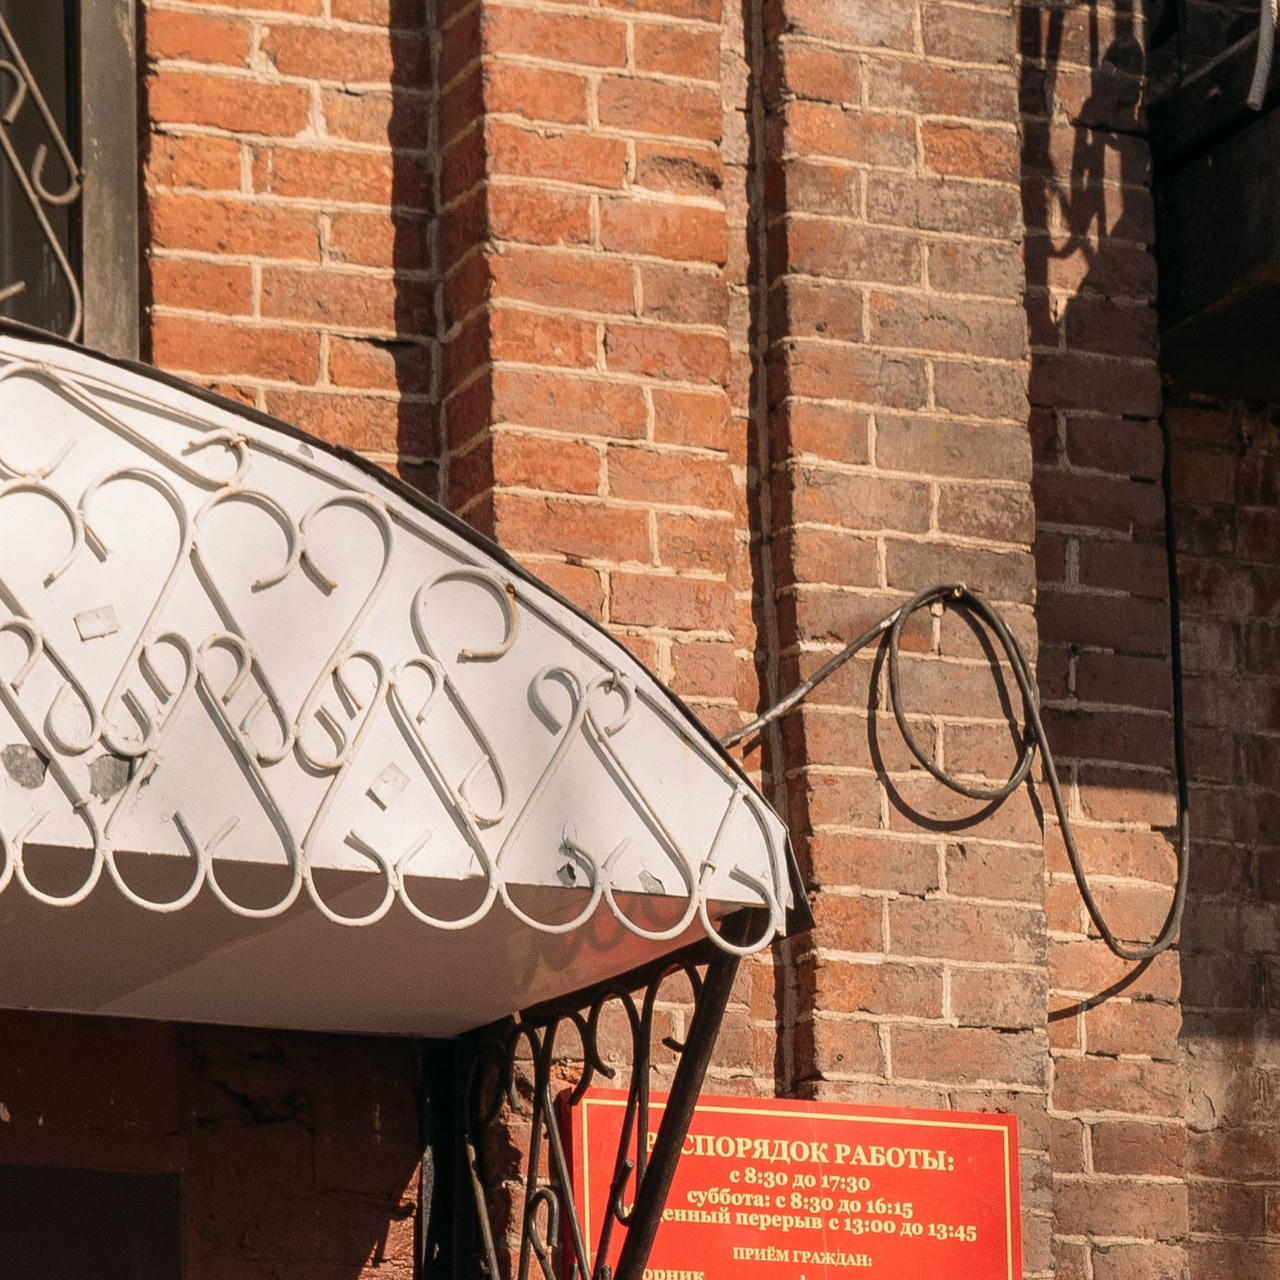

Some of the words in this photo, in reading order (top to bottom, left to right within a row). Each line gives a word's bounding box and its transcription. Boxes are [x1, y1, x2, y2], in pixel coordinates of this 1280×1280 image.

[647, 1132, 829, 1164] РСПОРЯДОК
[834, 1144, 954, 1171] РАБОТЫ:
[730, 1169, 740, 1183] с
[744, 1167, 788, 1188] 8:30
[792, 1173, 816, 1189] до
[821, 1175, 870, 1193] 17:30
[687, 1187, 770, 1207] суббота:
[775, 1196, 786, 1209] с
[791, 1192, 833, 1213] 8:30
[838, 1199, 861, 1214] до
[866, 1198, 913, 1219] 16:15
[736, 1211, 822, 1231] перерыв
[829, 1217, 839, 1230] с
[844, 1218, 896, 1235] 13:00
[900, 1222, 923, 1237] до
[928, 1223, 977, 1242] 13:45
[733, 1246, 790, 1262] ПРИЁМ
[793, 1250, 872, 1267] ГРАЖДАН:
